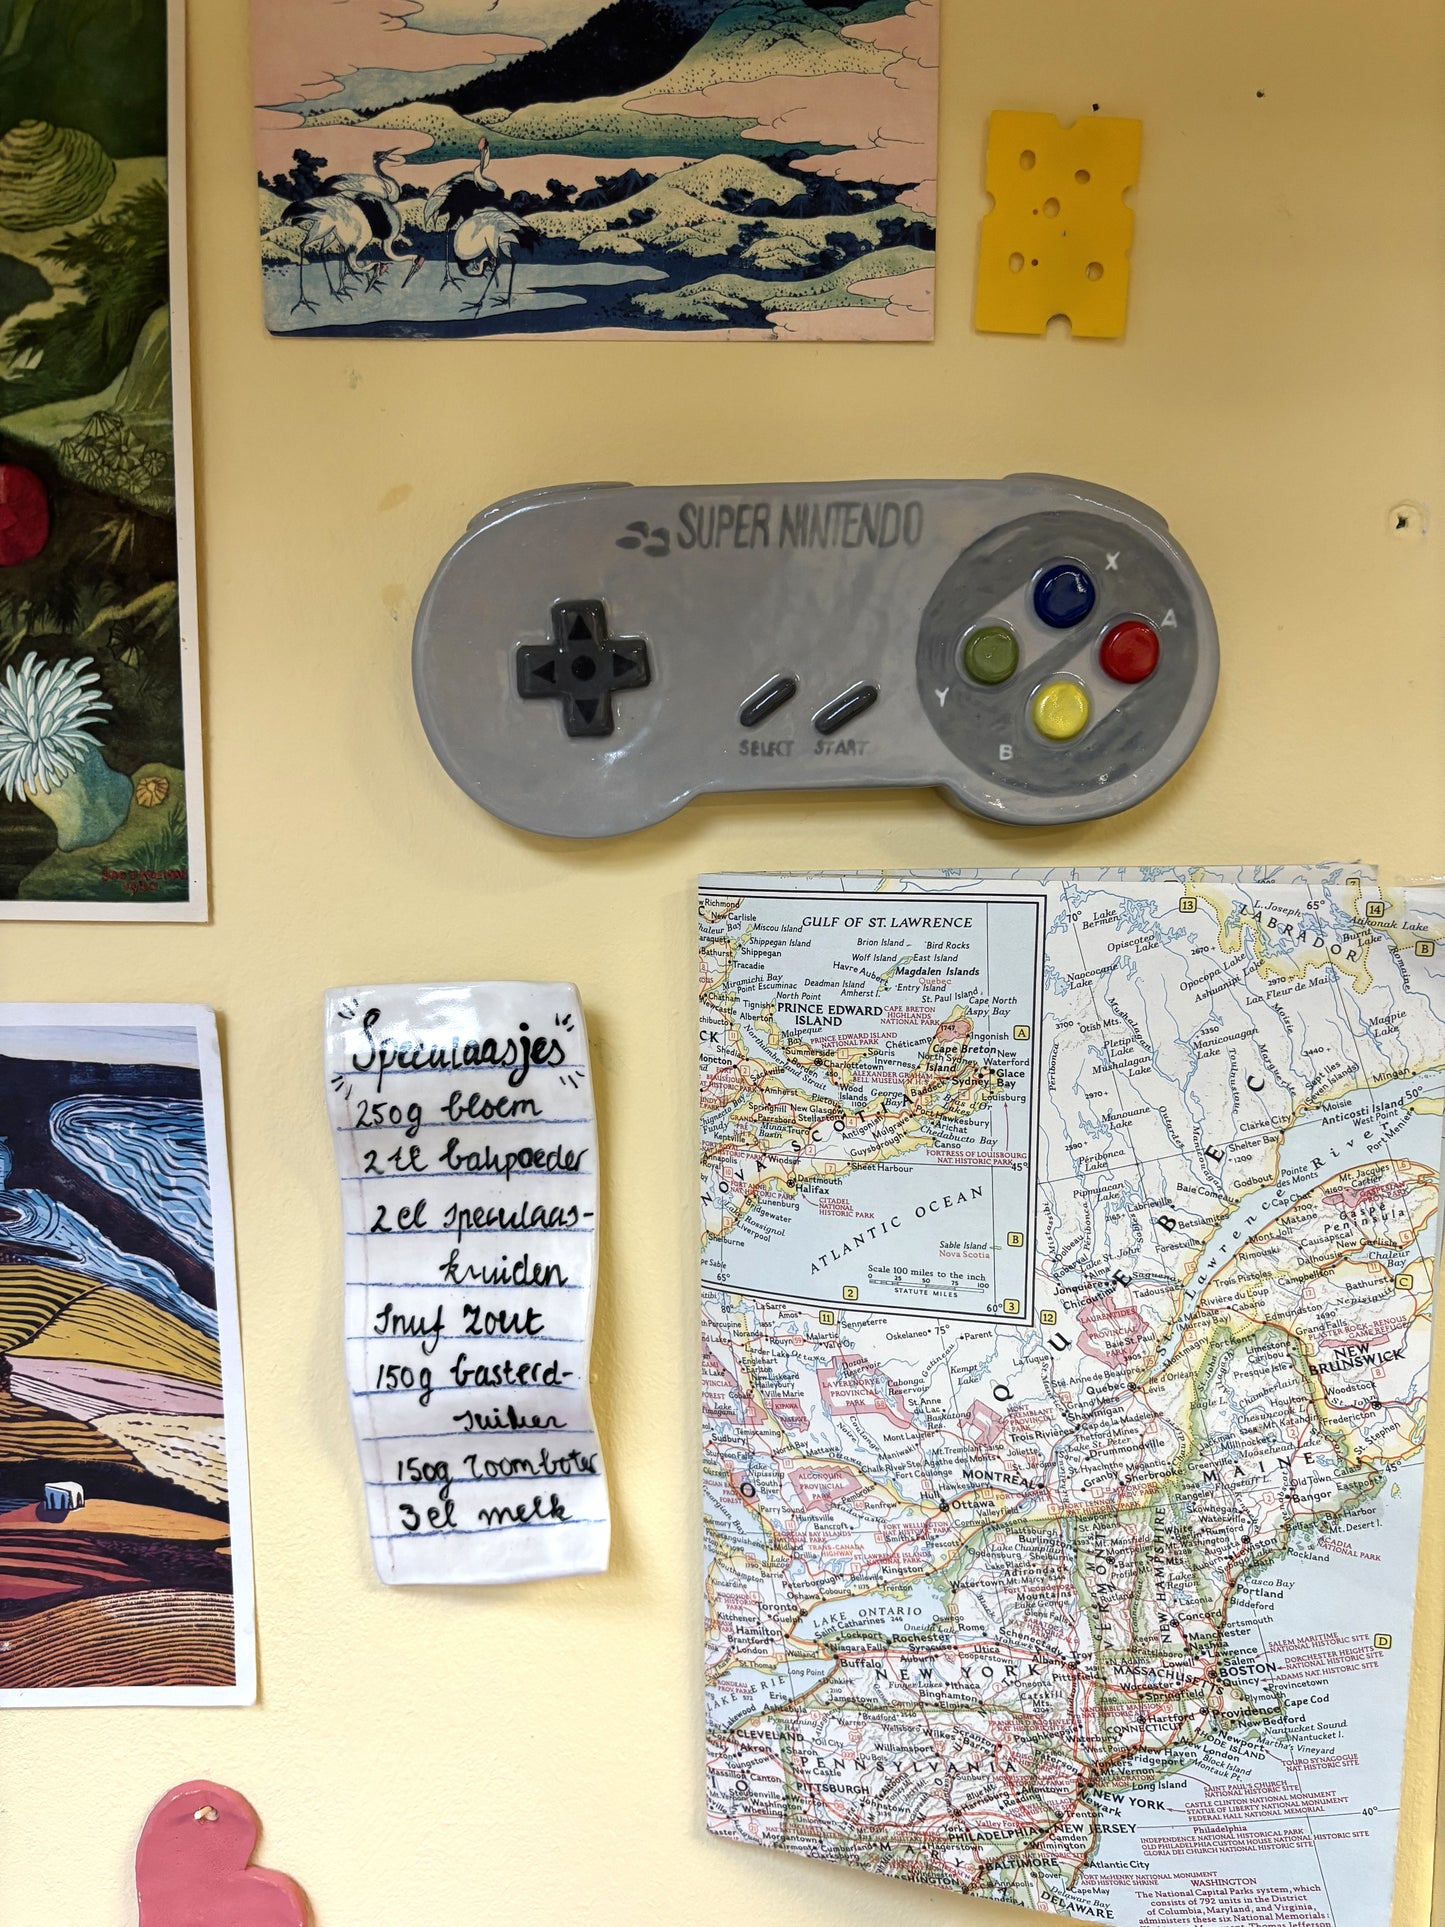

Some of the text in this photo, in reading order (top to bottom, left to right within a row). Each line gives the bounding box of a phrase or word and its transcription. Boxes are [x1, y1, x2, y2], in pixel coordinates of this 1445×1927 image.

[677, 501, 923, 550] SUPER NINTENDO
[1105, 552, 1120, 570] X
[1161, 608, 1177, 628] A
[934, 687, 949, 707] Y
[739, 739, 870, 757] SELECT START
[999, 744, 1013, 761] B
[1182, 901, 1193, 910] 13
[1306, 900, 1325, 910] 65°
[1369, 905, 1381, 914] 14
[802, 916, 973, 928] GULF OF ST. LAWRENCE
[1067, 910, 1082, 923] 70°
[741, 948, 781, 958] Shippegan
[1422, 944, 1429, 954] B
[913, 954, 958, 962] East Island
[733, 961, 765, 970] Tracadie
[895, 967, 980, 976] Magdalen Islands
[919, 977, 951, 985] Quebec
[778, 1003, 883, 1016] PRINCE EDWARD
[795, 1016, 843, 1027] ISLAND
[1369, 1010, 1407, 1027] Magpie
[971, 1032, 1009, 1041] Ingonish
[1018, 1029, 1026, 1037] A
[1375, 1025, 1399, 1038] Lake
[352, 1008, 566, 1093] Speculaasjes
[933, 1044, 997, 1054] Cape Breton
[926, 1064, 956, 1072] Island
[996, 1069, 1025, 1078] Glace
[1372, 1068, 1410, 1083] Mingan
[952, 1077, 990, 1087] Sydney
[997, 1079, 1016, 1089] Bay
[982, 1094, 1026, 1103] Louisburg
[356, 1090, 542, 1138] 250g bloem
[1322, 1099, 1404, 1126] Anticosti Island
[364, 1150, 384, 1174] 2
[440, 1137, 589, 1182] bakpoeder
[1011, 1162, 1028, 1171] 45°
[798, 1174, 843, 1186] Dartmouth
[796, 1184, 829, 1195] Halifax
[371, 1198, 594, 1243] 2 el speculaas-
[810, 1186, 983, 1275] ATLANTIC OCEAN
[1012, 1235, 1019, 1243] B
[939, 1241, 987, 1250] Sable Island
[939, 1250, 990, 1259] Nova Scotia
[439, 1248, 568, 1286] kruiden
[868, 1265, 986, 1281] Scale 100 miles to the inch
[717, 1273, 731, 1282] 65°
[1399, 1278, 1409, 1287] C
[847, 1290, 854, 1298] 2
[1133, 1285, 1179, 1299] Tadoussac
[987, 1303, 1002, 1313] 60°
[1008, 1302, 1015, 1311] 3
[822, 1314, 831, 1322] 11
[1043, 1313, 1053, 1322] 12
[885, 1330, 928, 1341] Oskelaneo
[934, 1325, 951, 1335] 75°
[964, 1331, 993, 1340] Parent
[1335, 1343, 1370, 1360] NEW
[1310, 1350, 1406, 1376] BRUNSWICK
[376, 1352, 574, 1407] 150g basterd-
[1087, 1382, 1125, 1395] Quebec
[453, 1404, 567, 1432] suiker
[1322, 1411, 1376, 1426] Fredericton
[712, 1433, 746, 1444] Sudbury
[1090, 1439, 1165, 1458] Drummondville
[398, 1457, 453, 1501] 150g
[962, 1470, 1035, 1490] MONTREAL
[1125, 1468, 1183, 1482] Sherbrooke
[1292, 1491, 1332, 1503] Bangor
[952, 1501, 995, 1509] Ottawa
[399, 1493, 572, 1531] 3 el melk
[1288, 1548, 1330, 1562] Rockland
[882, 1566, 923, 1576] Kingston
[1237, 1584, 1284, 1599] Portland
[758, 1602, 798, 1611] Toronto
[813, 1606, 923, 1628] LAKE ONTARIO
[1178, 1610, 1222, 1621] Concord
[736, 1626, 782, 1637] Hamilton
[892, 1633, 949, 1643] Rochester
[1268, 1632, 1338, 1648] SALEM MARITIME
[1379, 1637, 1388, 1646] D
[841, 1659, 882, 1668] Buffalo
[1223, 1657, 1256, 1667] Salem
[875, 1664, 1041, 1682] NEW YORK
[1220, 1662, 1277, 1677] BOSTON
[1114, 1666, 1225, 1695] MASSACHUSETTS
[1268, 1678, 1329, 1692] Provincetown
[1284, 1694, 1330, 1708] Cape Cod
[1107, 1722, 1182, 1734] CONNECTICUT
[736, 1730, 804, 1742] CLEVELAND
[796, 1783, 870, 1795] PITTSBURGH
[1132, 1780, 1187, 1792] Long Island
[1093, 1788, 1165, 1810] NEW YORK
[1362, 1806, 1378, 1816] 40°
[948, 1827, 1039, 1843] PHILADELPHIA
[1054, 1823, 1137, 1835] NEW JERSEY
[1193, 1825, 1248, 1834] Philadelphia
[986, 1858, 1060, 1871] BALTIMORE
[1089, 1860, 1150, 1870] Atlantic City
[1191, 1878, 1257, 1887] WASHINGTON
[1135, 1884, 1321, 1898] The National Capital Parks system, which
[1040, 1890, 1115, 1920] DELAWARE
